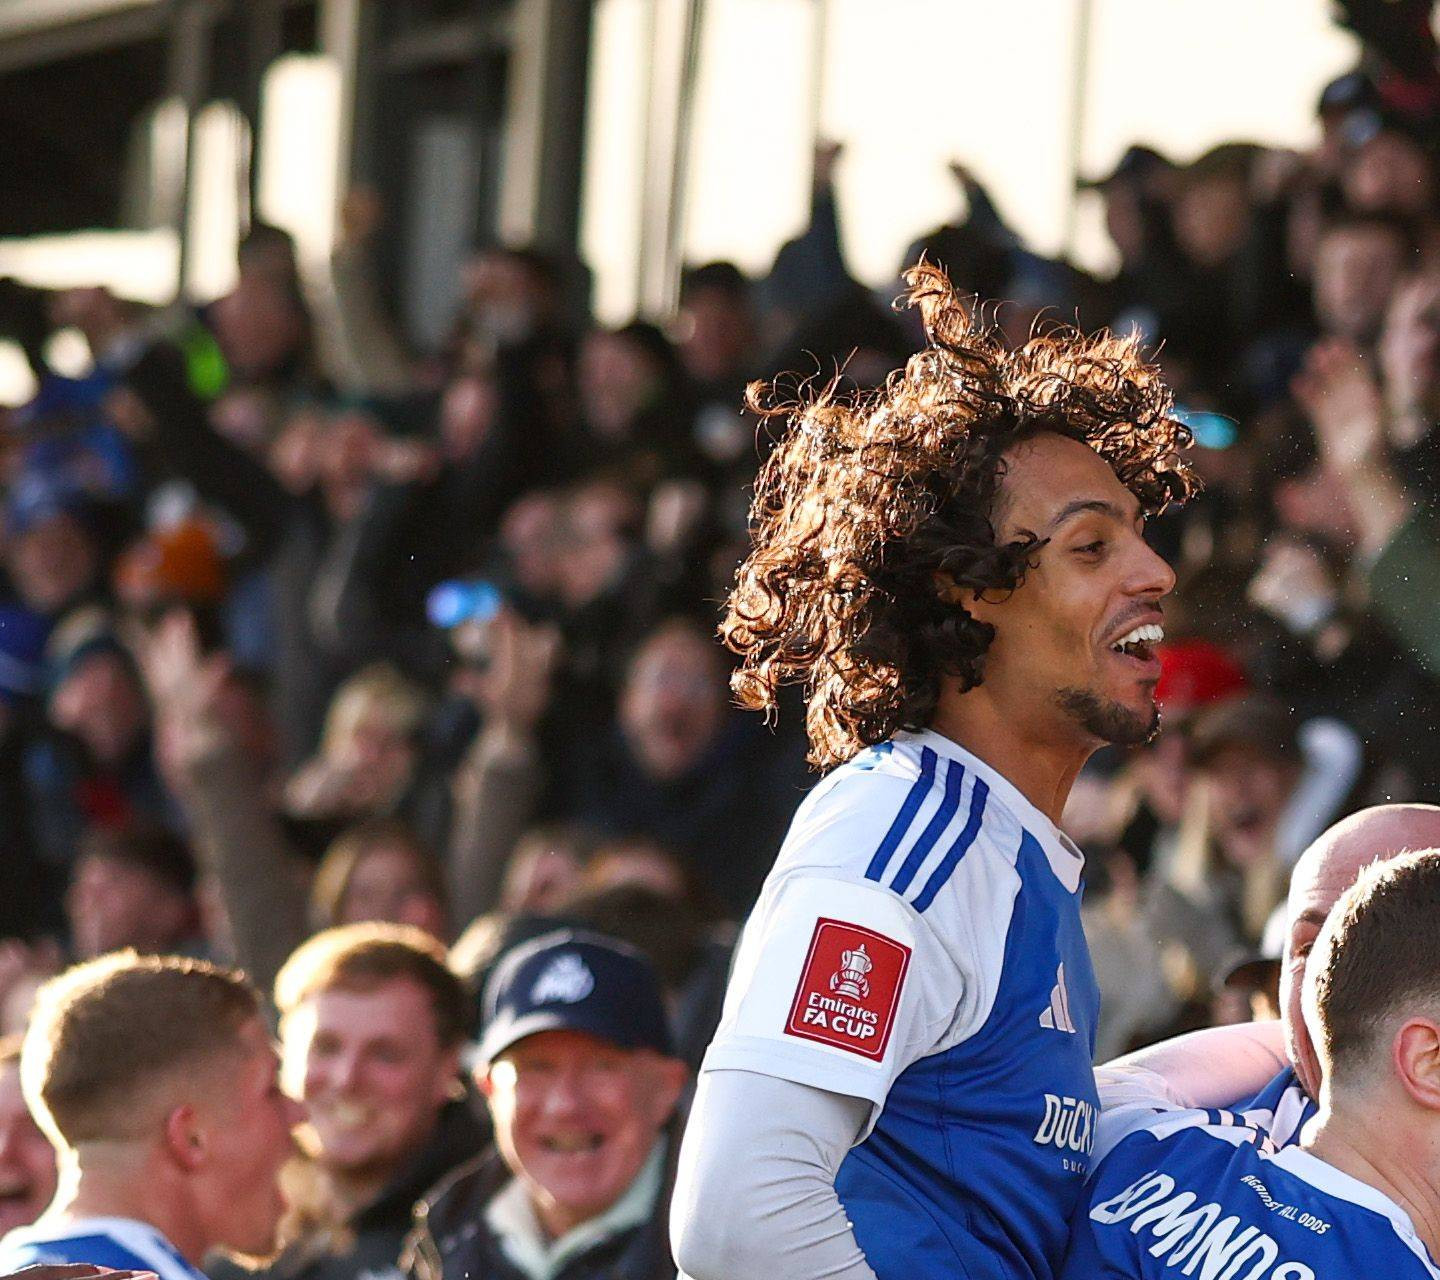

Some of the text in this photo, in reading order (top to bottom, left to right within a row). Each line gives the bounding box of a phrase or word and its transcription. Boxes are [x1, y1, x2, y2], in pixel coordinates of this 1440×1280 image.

[802, 1007, 875, 1040] FA CUP
[808, 991, 879, 1025] Emirates
[1240, 1174, 1332, 1235] AGAINST ALL ODDS
